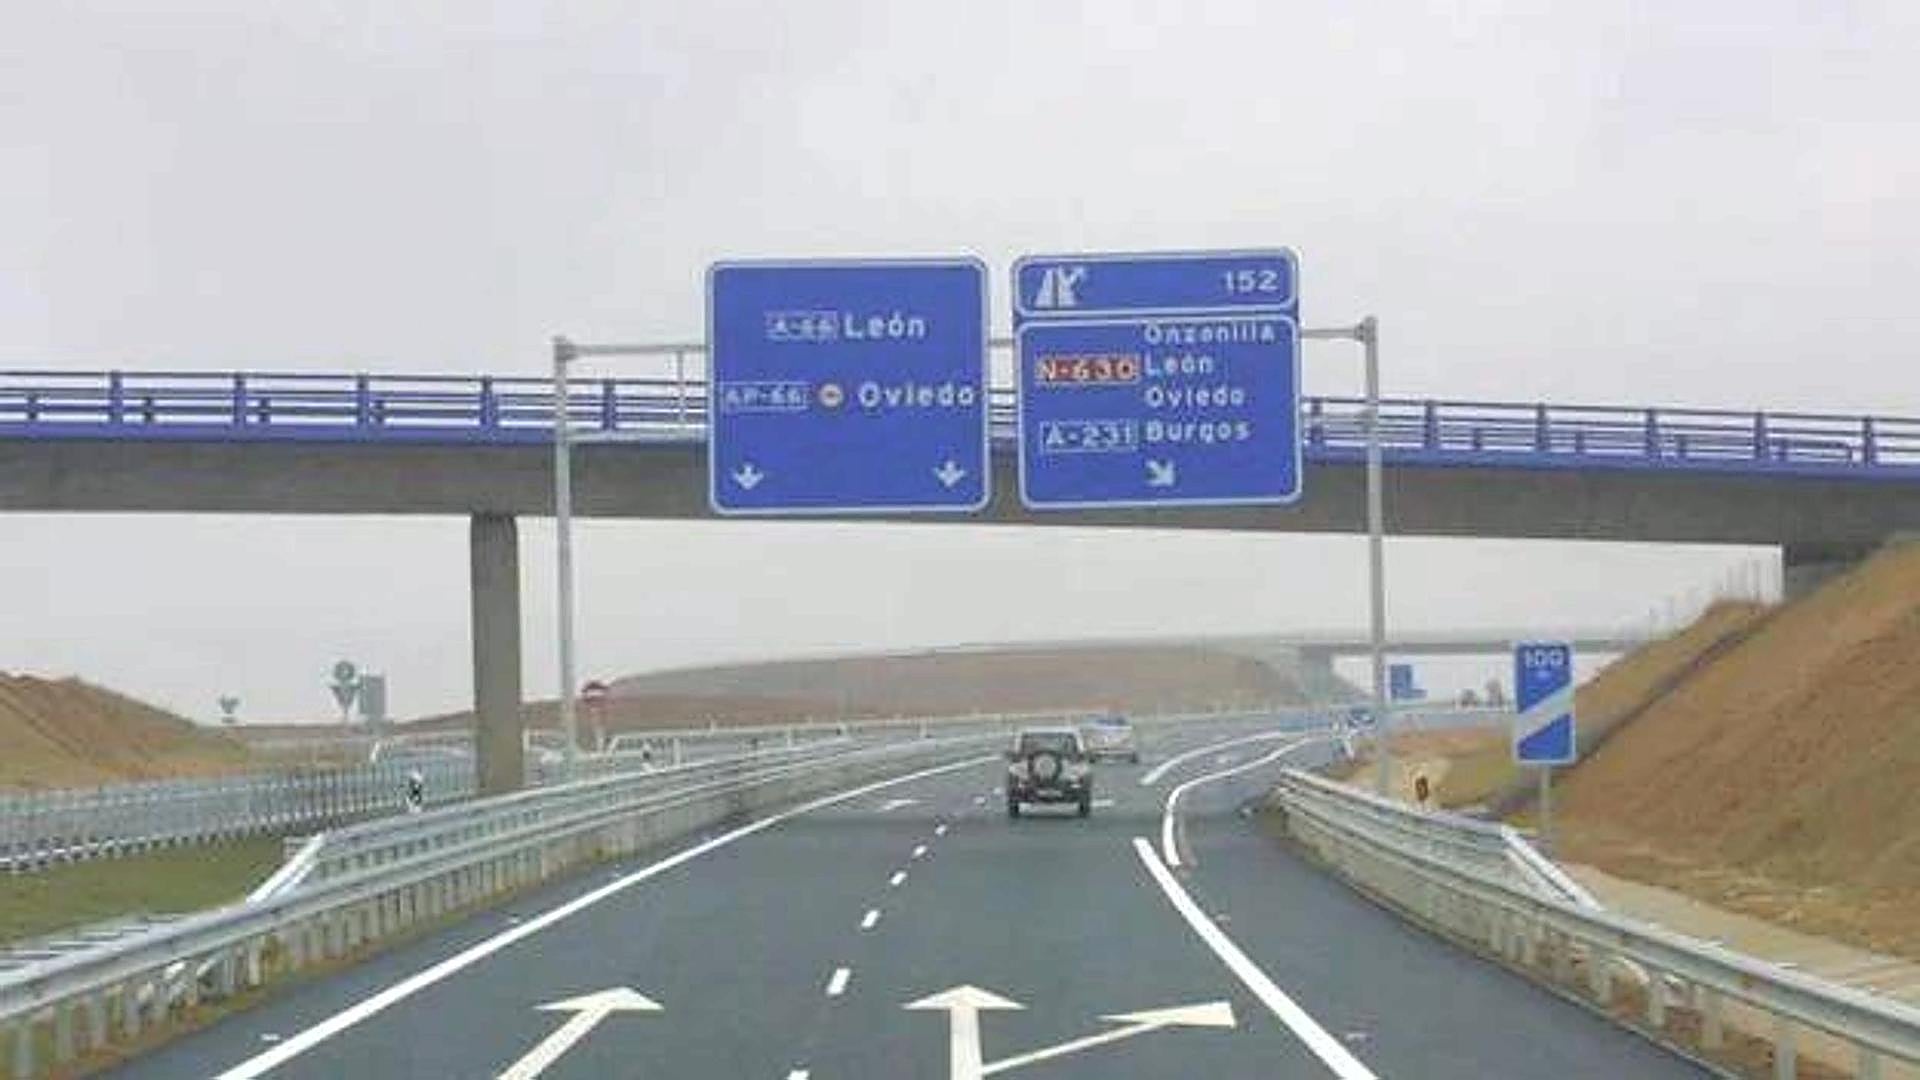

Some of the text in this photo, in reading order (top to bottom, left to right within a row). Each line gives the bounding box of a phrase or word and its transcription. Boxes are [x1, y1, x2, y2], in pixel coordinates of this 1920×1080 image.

[1225, 270, 1279, 293] 152
[844, 311, 927, 339] León
[1038, 351, 1214, 382] N-630 León
[858, 381, 975, 408] Oviedo
[1145, 386, 1246, 408] Oviedo
[1045, 420, 1250, 446] A-231 Burgos
[1525, 648, 1563, 668] 100
